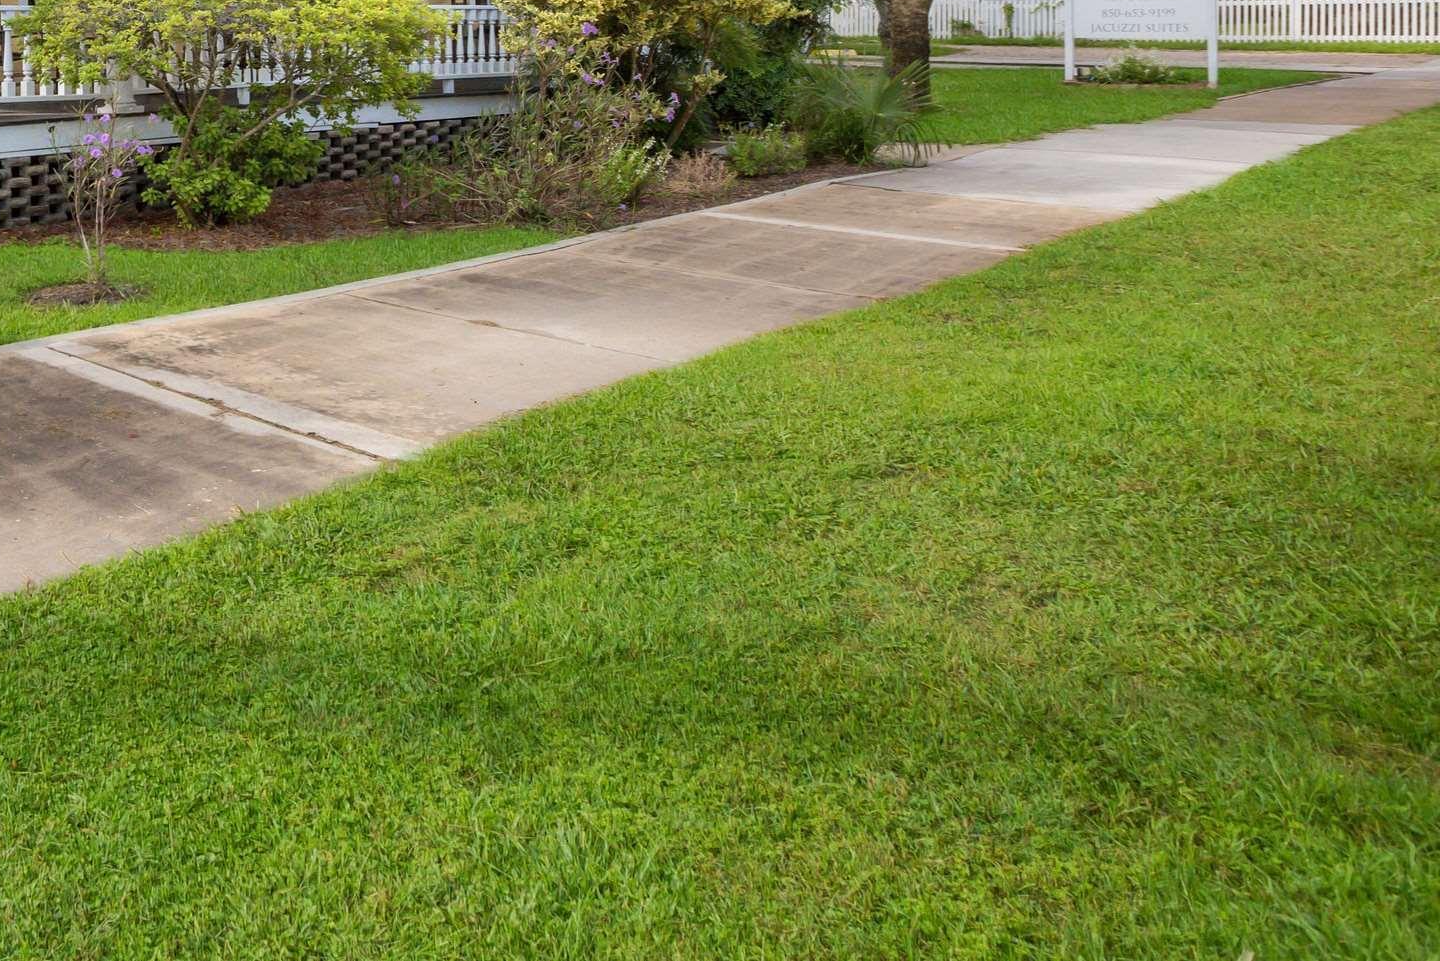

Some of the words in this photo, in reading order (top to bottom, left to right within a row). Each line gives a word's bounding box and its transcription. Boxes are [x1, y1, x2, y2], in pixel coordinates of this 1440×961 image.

[1102, 8, 1176, 18] 850-653-9199
[1091, 23, 1140, 33] JACUZZI
[1145, 23, 1190, 33] SUITES
